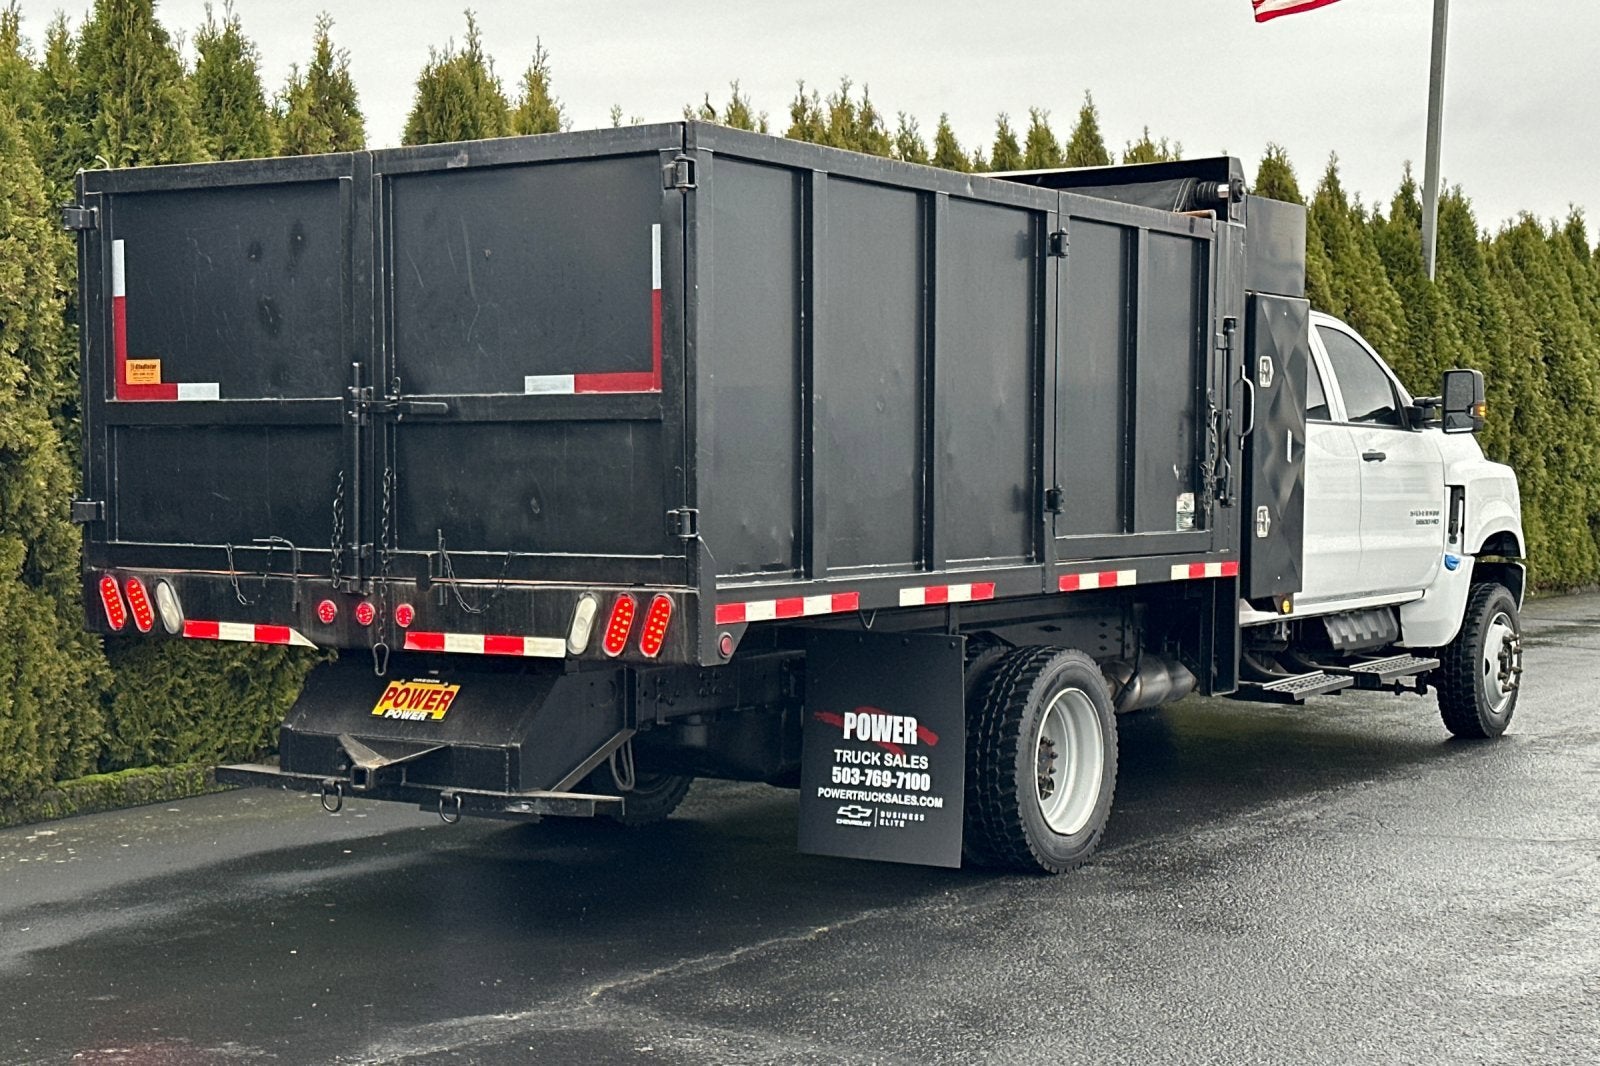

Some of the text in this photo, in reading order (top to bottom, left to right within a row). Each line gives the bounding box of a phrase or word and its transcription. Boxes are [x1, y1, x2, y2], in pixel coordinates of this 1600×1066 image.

[379, 687, 455, 711] POWER
[384, 709, 428, 721] POWER
[844, 712, 918, 745] POWER
[834, 749, 929, 769] TRUCK SALES
[832, 767, 931, 791] 503-769-7100
[818, 787, 943, 808] POWERTRUCKSALES.COM
[879, 819, 905, 828] ELITE
[880, 810, 925, 822] BUSINESS
